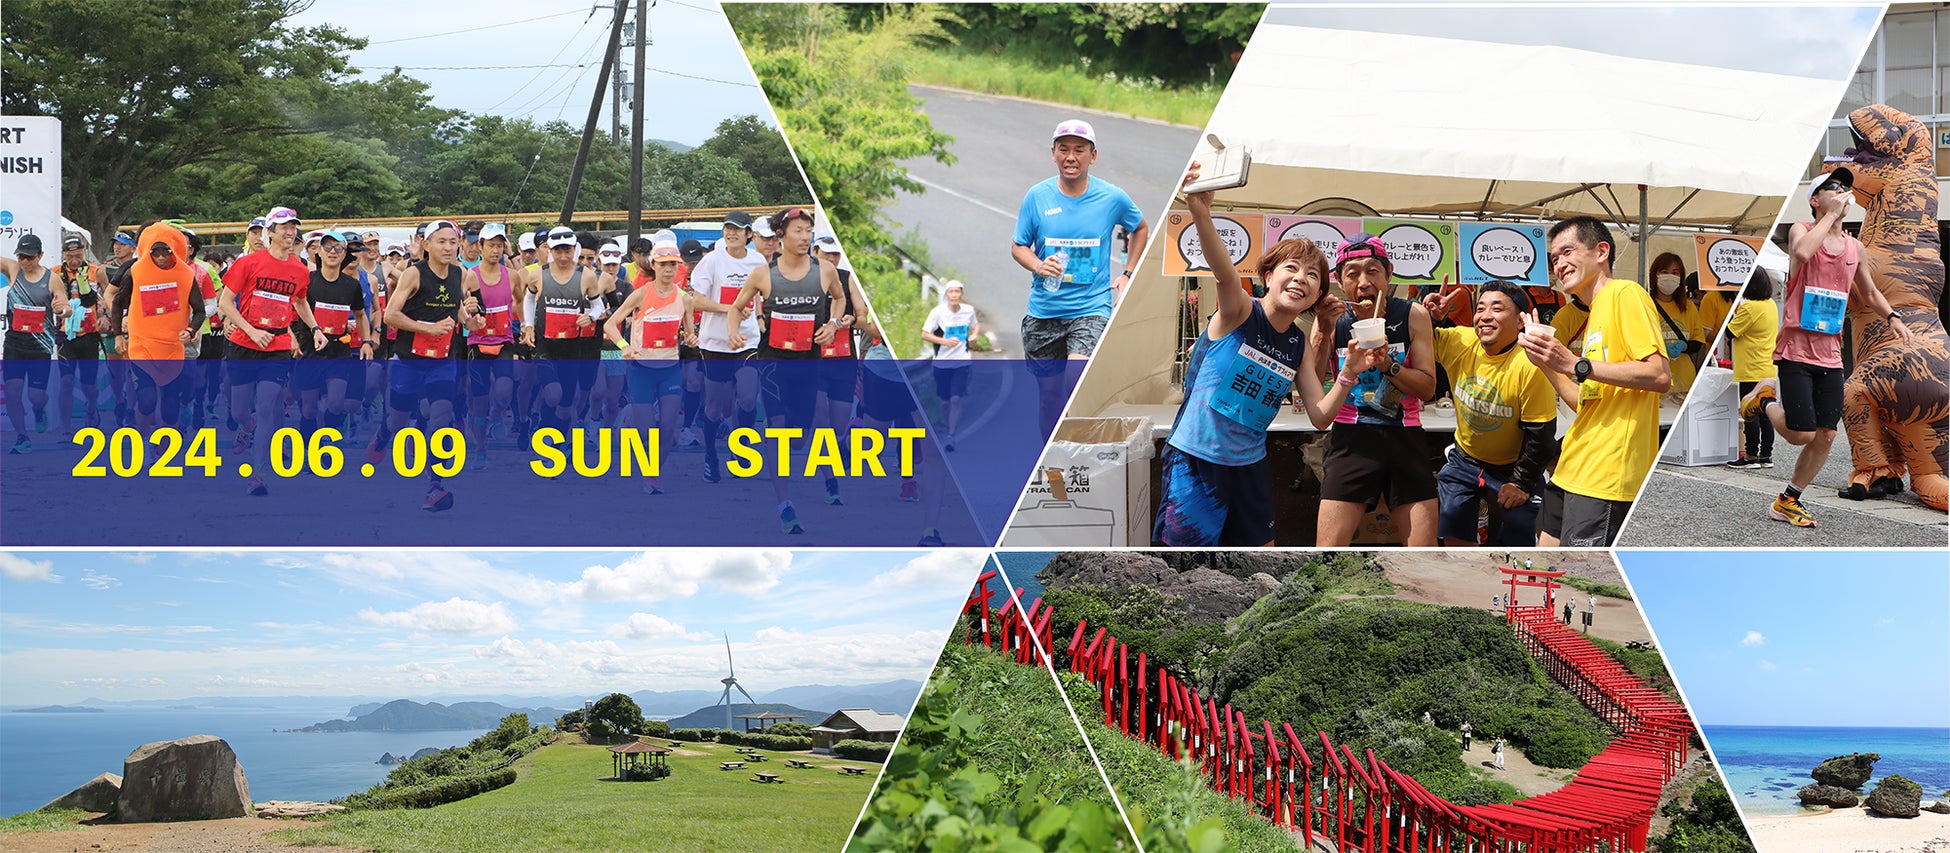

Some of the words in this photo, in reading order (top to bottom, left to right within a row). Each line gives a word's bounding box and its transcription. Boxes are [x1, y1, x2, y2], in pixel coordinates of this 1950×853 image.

[1481, 243, 1524, 253] 良いペース！
[1478, 253, 1531, 264] カレーでひと息
[544, 296, 579, 307] Legacy
[774, 295, 820, 305] Legacy
[1244, 349, 1258, 360] JAL
[1230, 372, 1263, 400] 吉田
